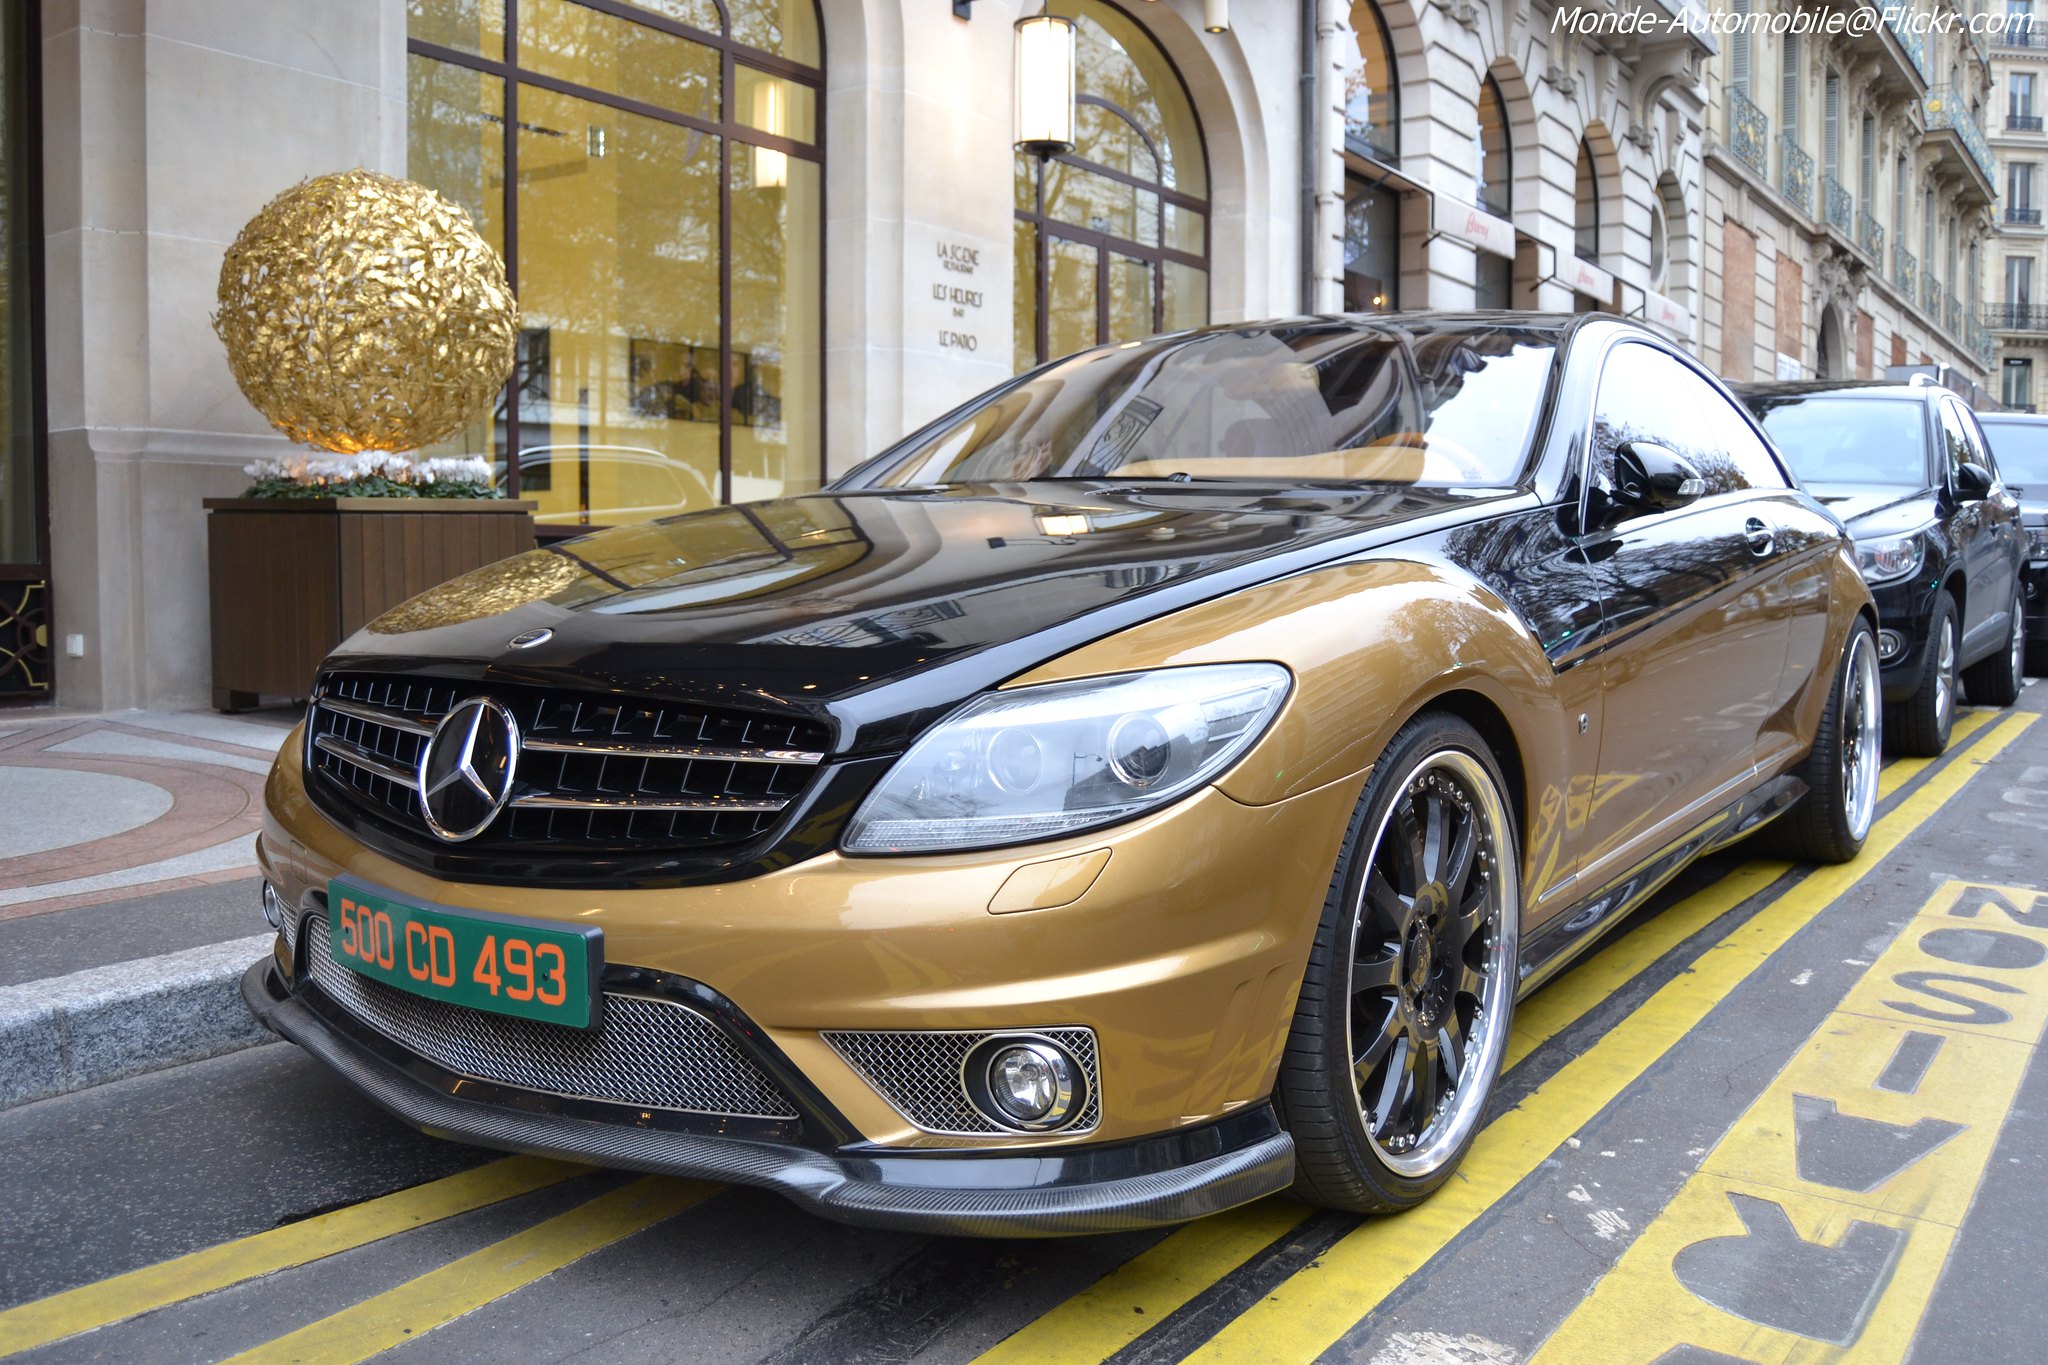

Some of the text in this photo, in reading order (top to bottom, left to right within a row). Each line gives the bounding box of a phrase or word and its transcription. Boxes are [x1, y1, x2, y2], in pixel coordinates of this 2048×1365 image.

[937, 241, 948, 258] LA
[933, 283, 983, 308] LES HEURES
[940, 329, 977, 351] LE PATIO
[340, 898, 567, 1006] 500 CD 493
[1646, 886, 2048, 1365] RAISON
